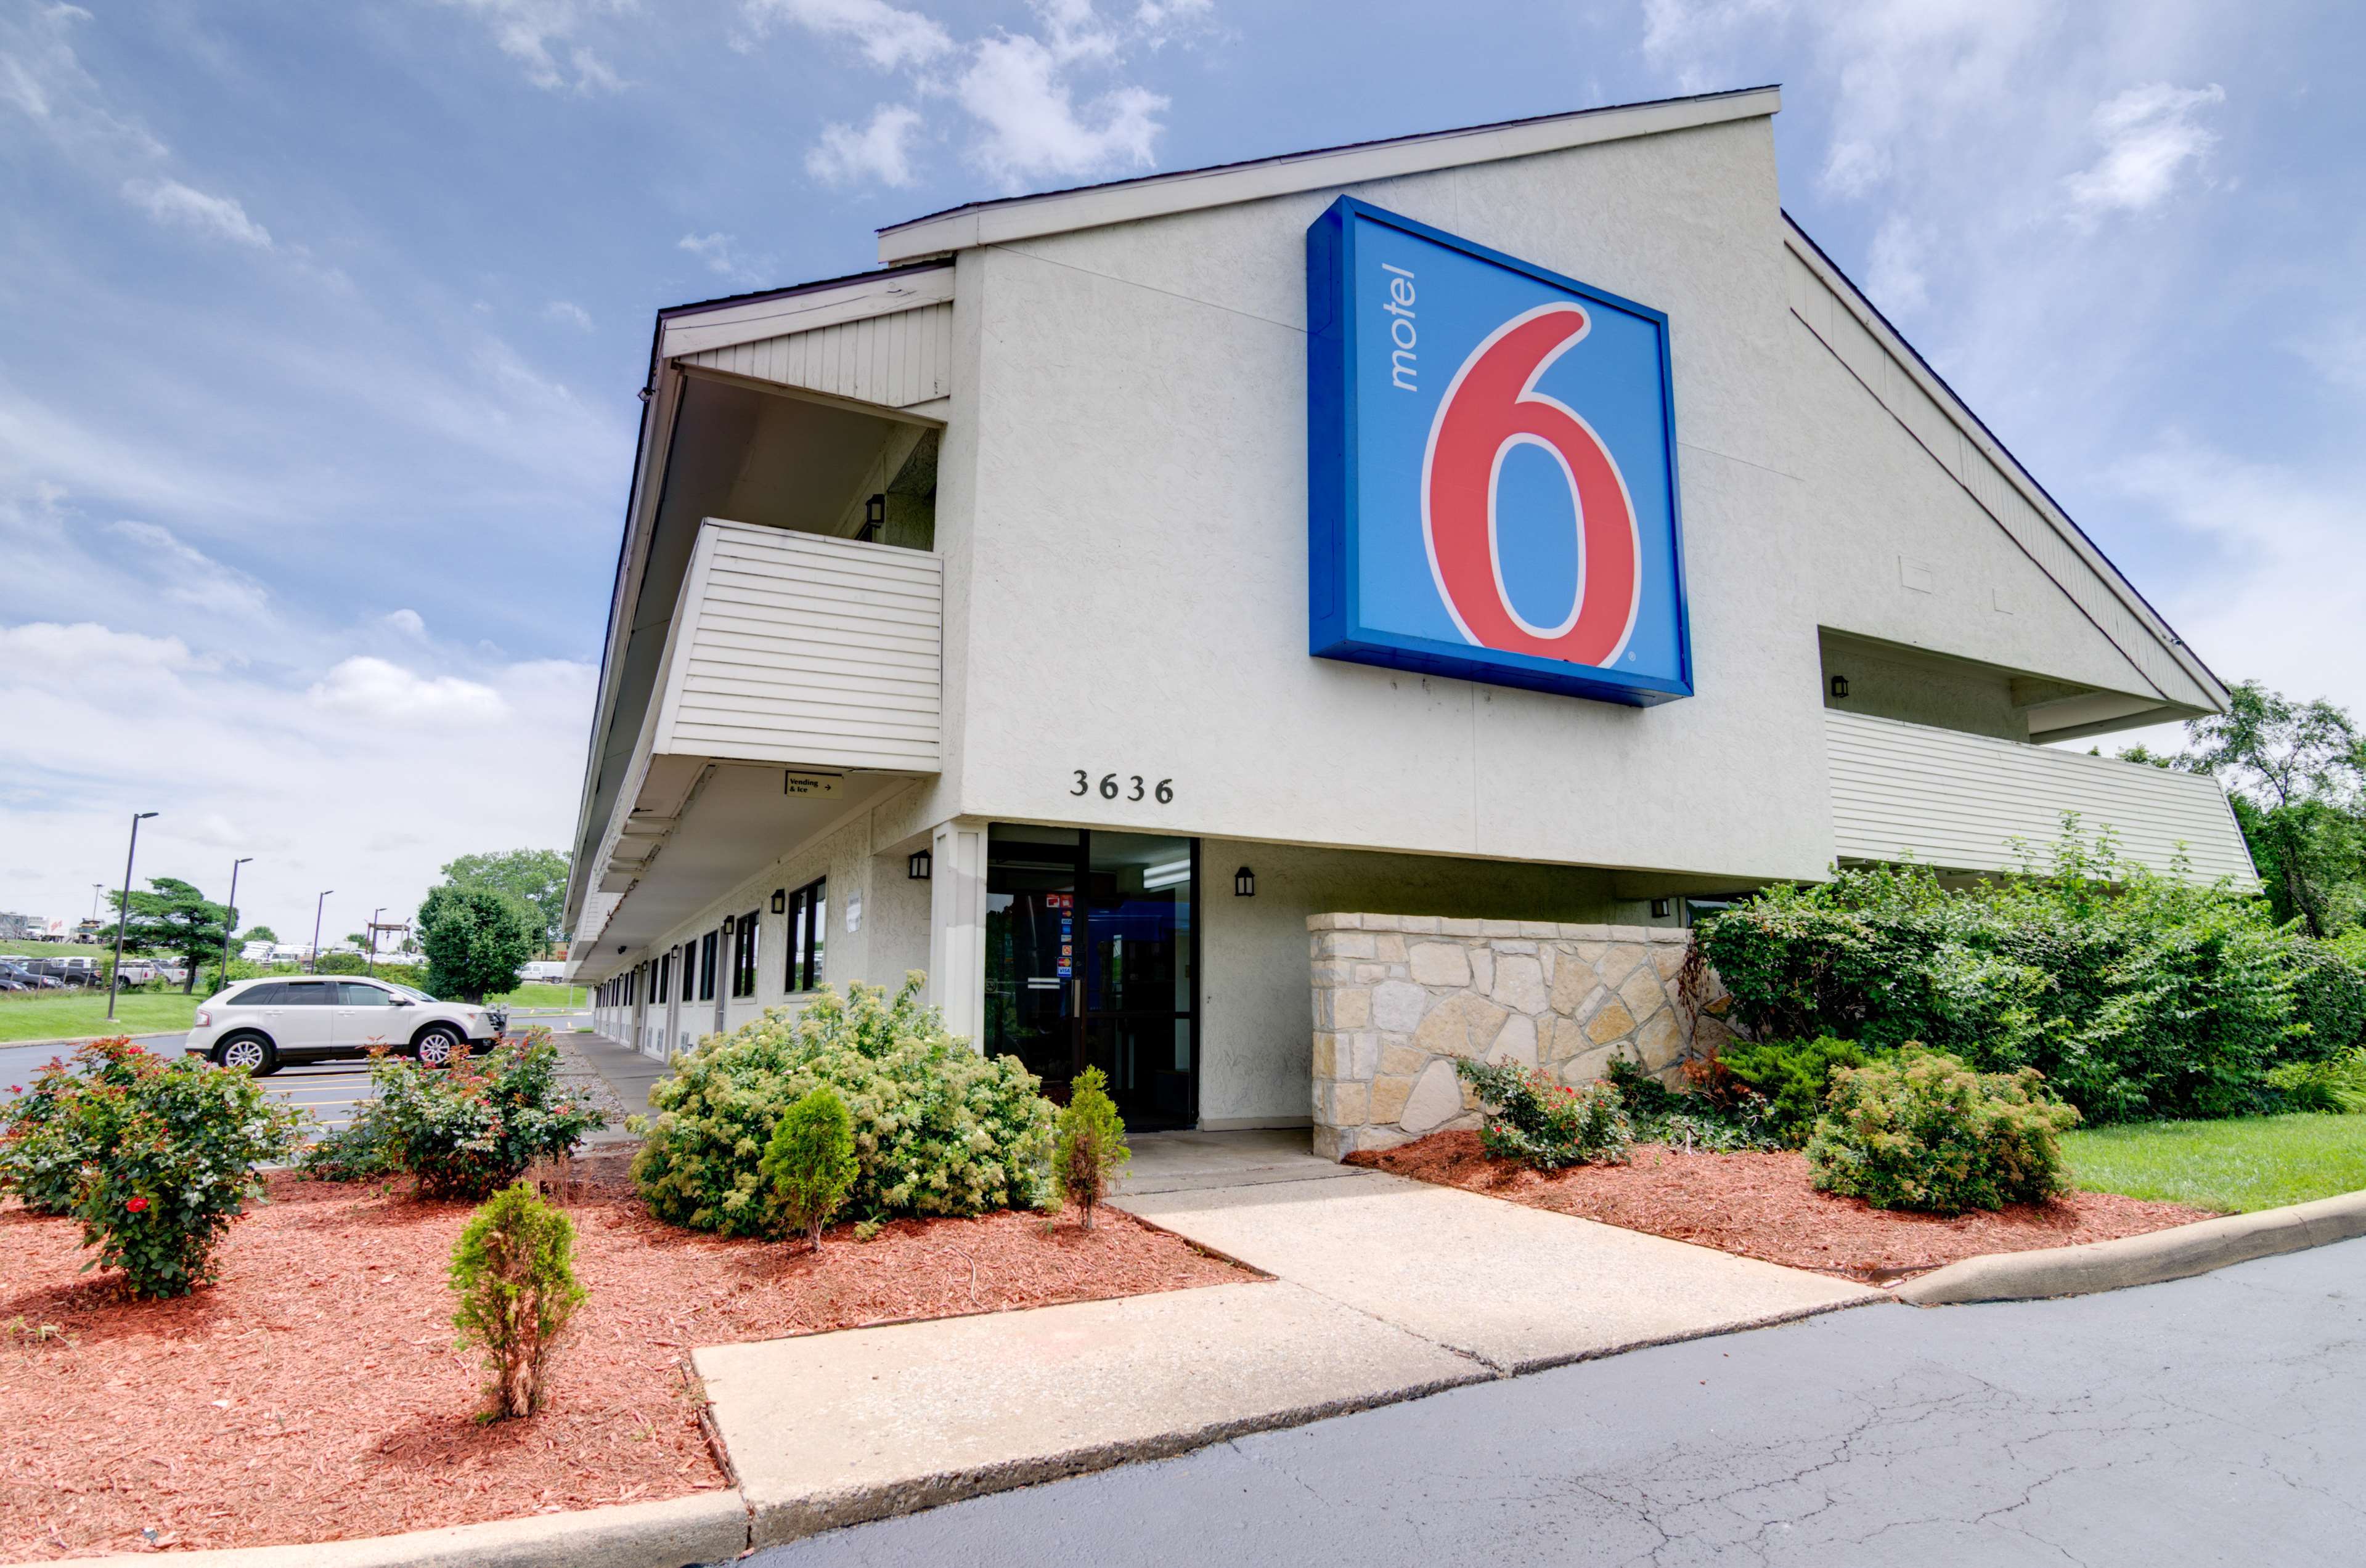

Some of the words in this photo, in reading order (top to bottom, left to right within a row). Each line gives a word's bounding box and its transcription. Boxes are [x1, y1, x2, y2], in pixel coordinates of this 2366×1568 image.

[1382, 262, 1418, 392] motel
[1421, 301, 1642, 668] 6
[790, 779, 818, 788] Vending
[1070, 770, 1173, 804] 3636
